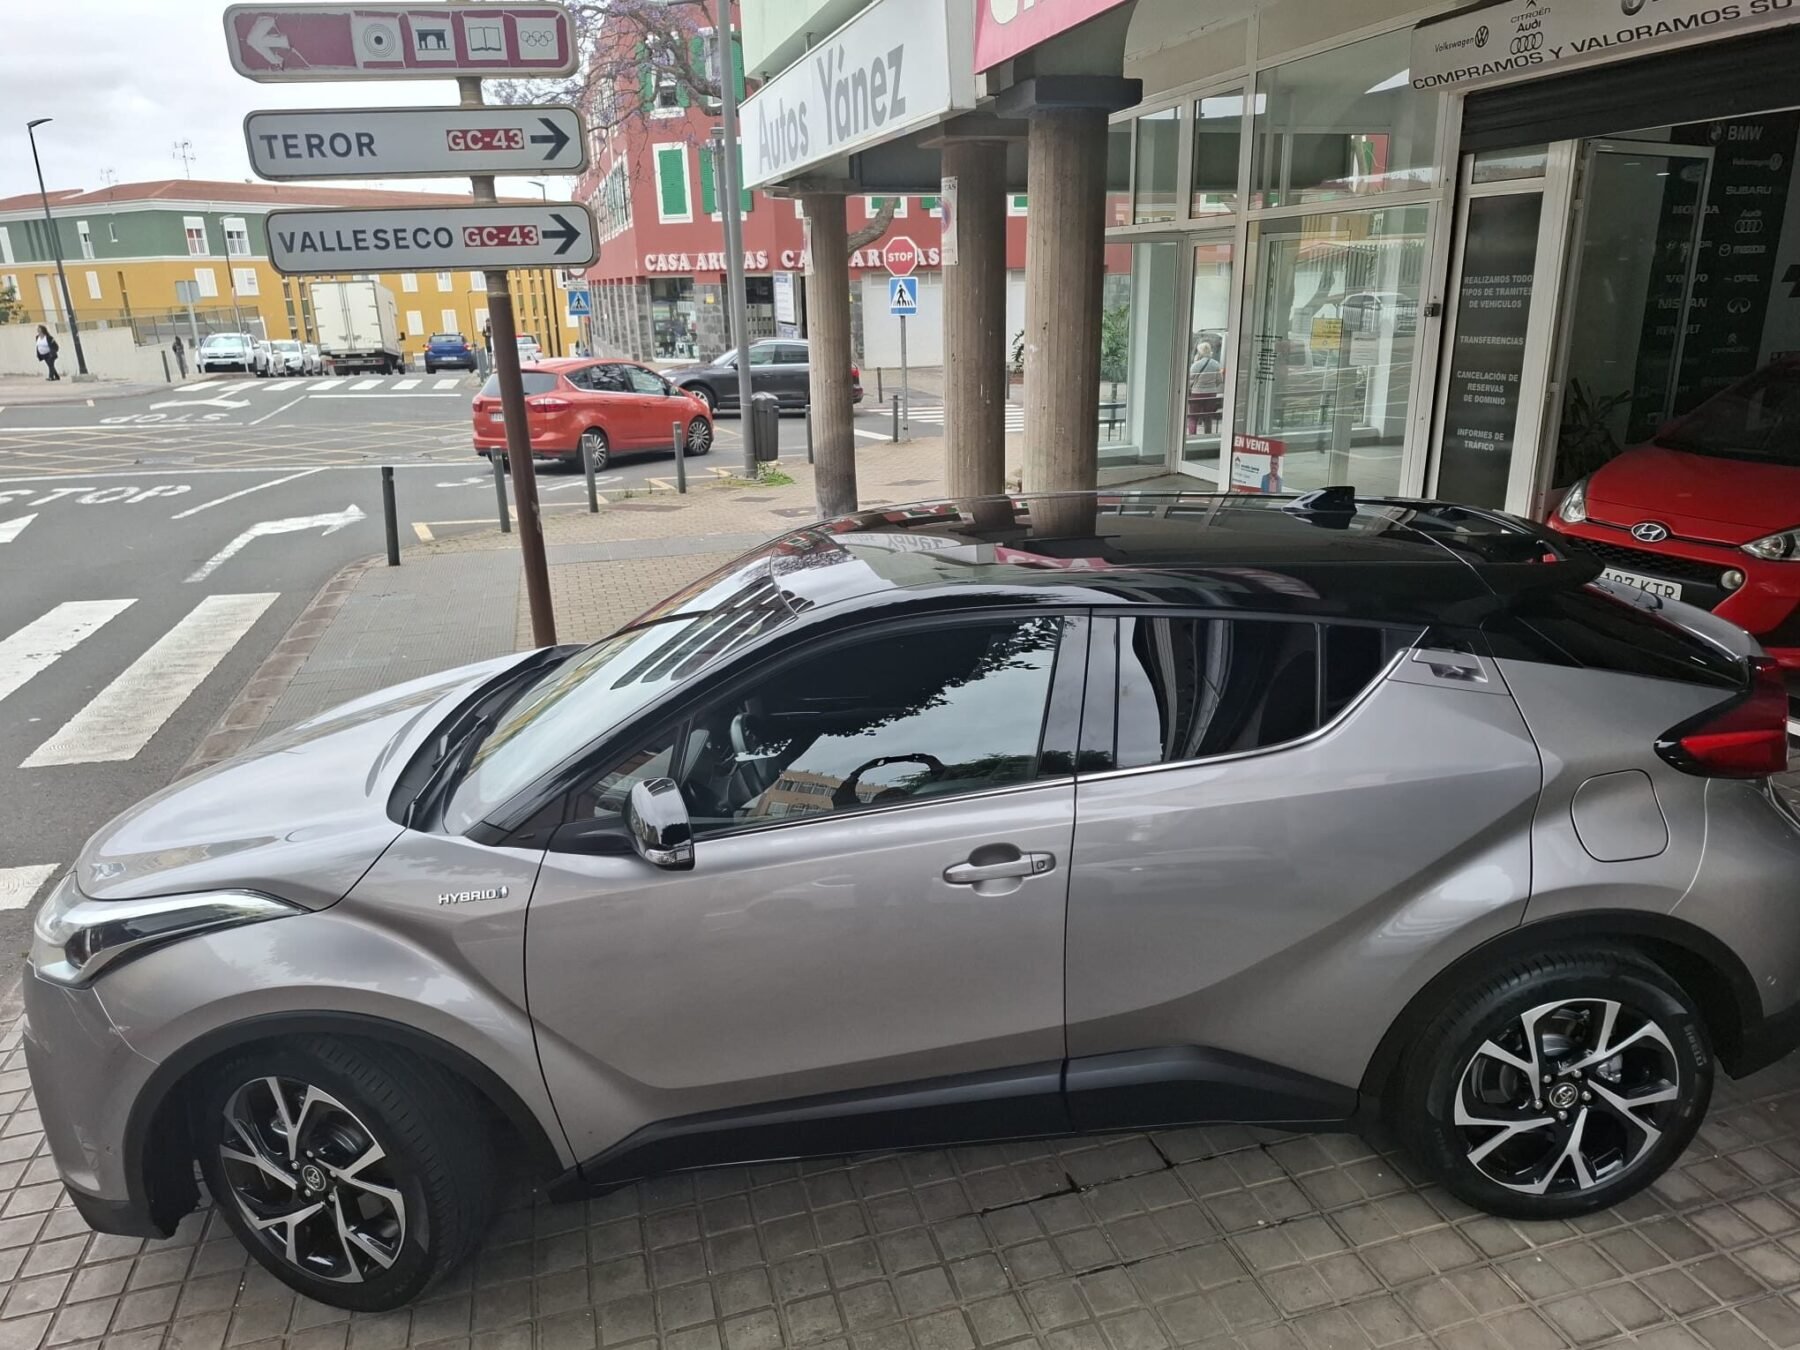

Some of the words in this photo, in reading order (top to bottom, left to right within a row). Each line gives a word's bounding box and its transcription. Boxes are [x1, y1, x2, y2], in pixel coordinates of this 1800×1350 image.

[1516, 19, 1541, 33] Audi
[1413, 51, 1543, 90] COMPRAMOS
[1550, 46, 1563, 59] Y
[1571, 4, 1741, 53] VALORAMOS
[1434, 37, 1474, 53] Volkswagen
[758, 97, 809, 174] Autos
[816, 43, 906, 145] Yánez
[1728, 126, 1763, 141] BMW
[259, 131, 378, 160] TEROR
[447, 128, 524, 151] GC-43
[1726, 185, 1772, 195] SUBARU
[1672, 205, 1720, 214] HODA
[278, 226, 454, 254] VALLESECO
[463, 225, 538, 247] GC-43
[645, 253, 692, 271] CASA
[696, 250, 769, 271] ARUAS
[887, 252, 913, 263] STOP
[1464, 275, 1510, 284] REALIZAMOS
[1512, 274, 1533, 283] TODO
[1665, 274, 1709, 283] VOVO
[1462, 287, 1482, 296] TIPOS
[1484, 287, 1494, 296] DE
[1469, 300, 1479, 308] DE
[1658, 298, 1708, 309] NISAN
[1460, 335, 1524, 345] TRANSFERENCIAS
[1508, 373, 1519, 382] DE
[1467, 383, 1504, 393] RESERVAS
[1463, 394, 1473, 402] DE
[1474, 395, 1506, 405] DOMINIO
[1457, 428, 1493, 439] INFORMES
[1494, 432, 1505, 440] DE
[1234, 435, 1244, 447] EN
[1246, 437, 1270, 453] VENTA
[438, 888, 497, 904] HYBRID
